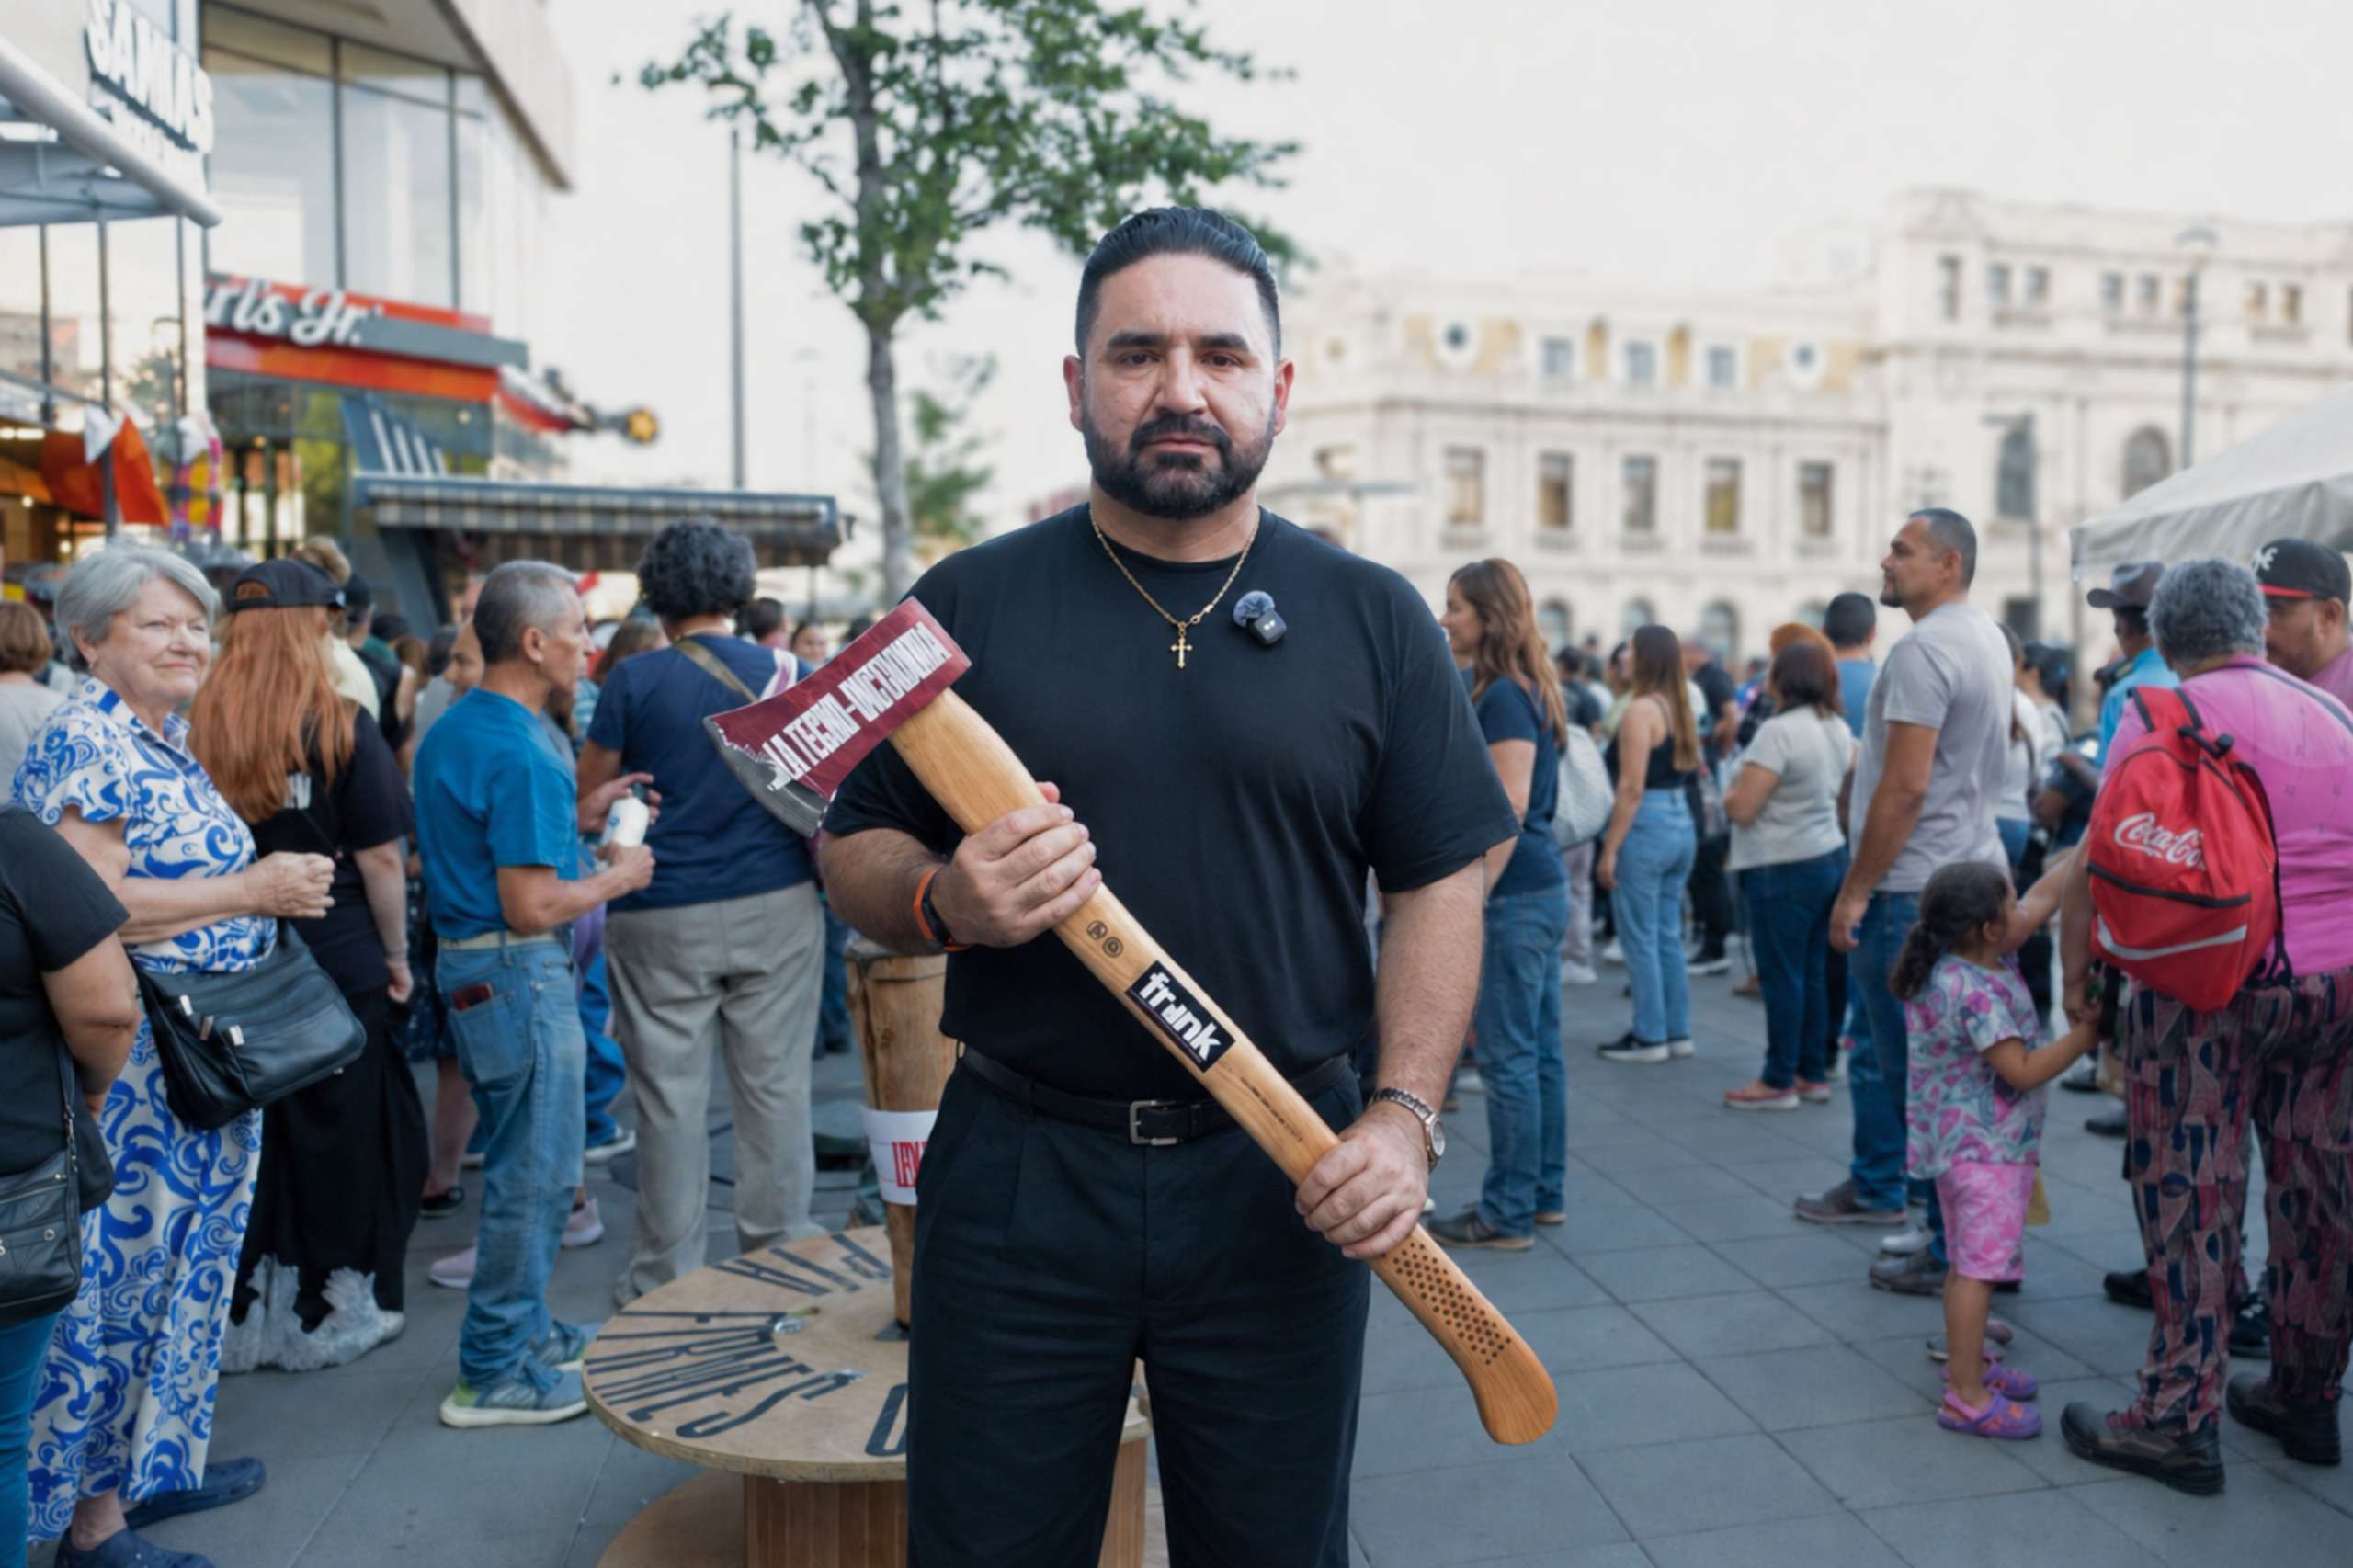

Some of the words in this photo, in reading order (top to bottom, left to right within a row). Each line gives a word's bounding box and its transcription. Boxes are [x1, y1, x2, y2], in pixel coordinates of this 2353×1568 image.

[205, 276, 281, 336] rl's
[290, 286, 369, 347] Jr.
[2114, 812, 2205, 870] Coca-Co
[1139, 971, 1222, 1061] frank
